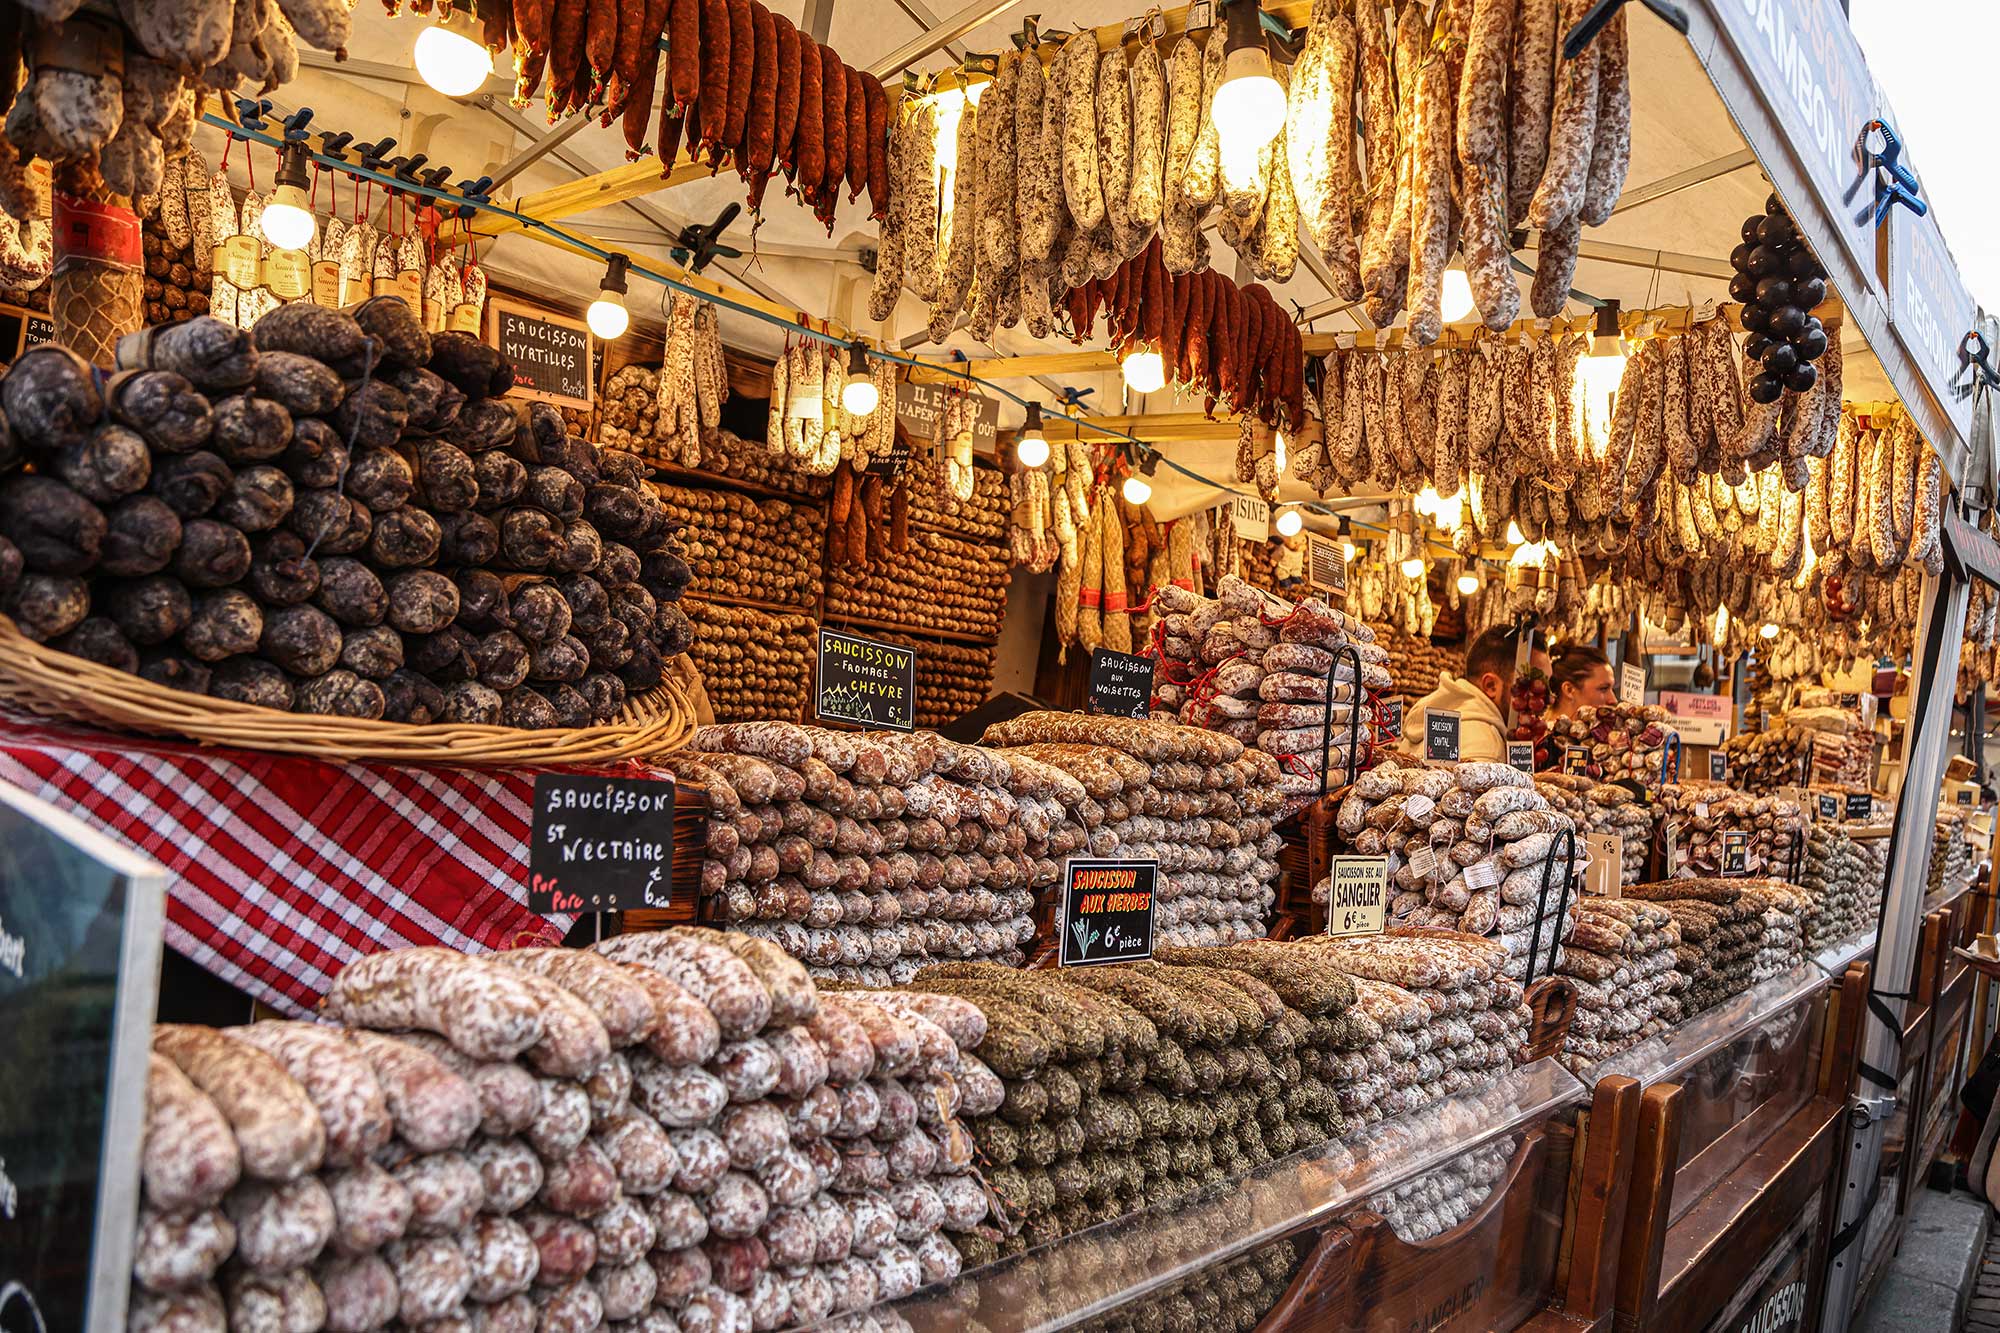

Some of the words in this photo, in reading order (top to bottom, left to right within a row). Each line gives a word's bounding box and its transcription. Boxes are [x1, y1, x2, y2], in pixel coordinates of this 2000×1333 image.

[824, 639, 909, 669] SAUCISSON
[842, 660, 889, 679] FROMAGE
[1100, 656, 1151, 674] SAUCISSON
[850, 680, 904, 699] CHEVRE
[1096, 683, 1141, 699] NOISETTES
[546, 788, 668, 815] SAUCISSON
[1072, 869, 1137, 890] SAUCISSON
[1337, 867, 1364, 879] SAUCISSON
[1365, 867, 1375, 878] SEC
[1375, 867, 1383, 878] AU
[1080, 893, 1106, 914] AUX
[1106, 892, 1151, 913] HERBES
[1336, 882, 1380, 908] SANGLIER
[1119, 936, 1142, 952] pièce
